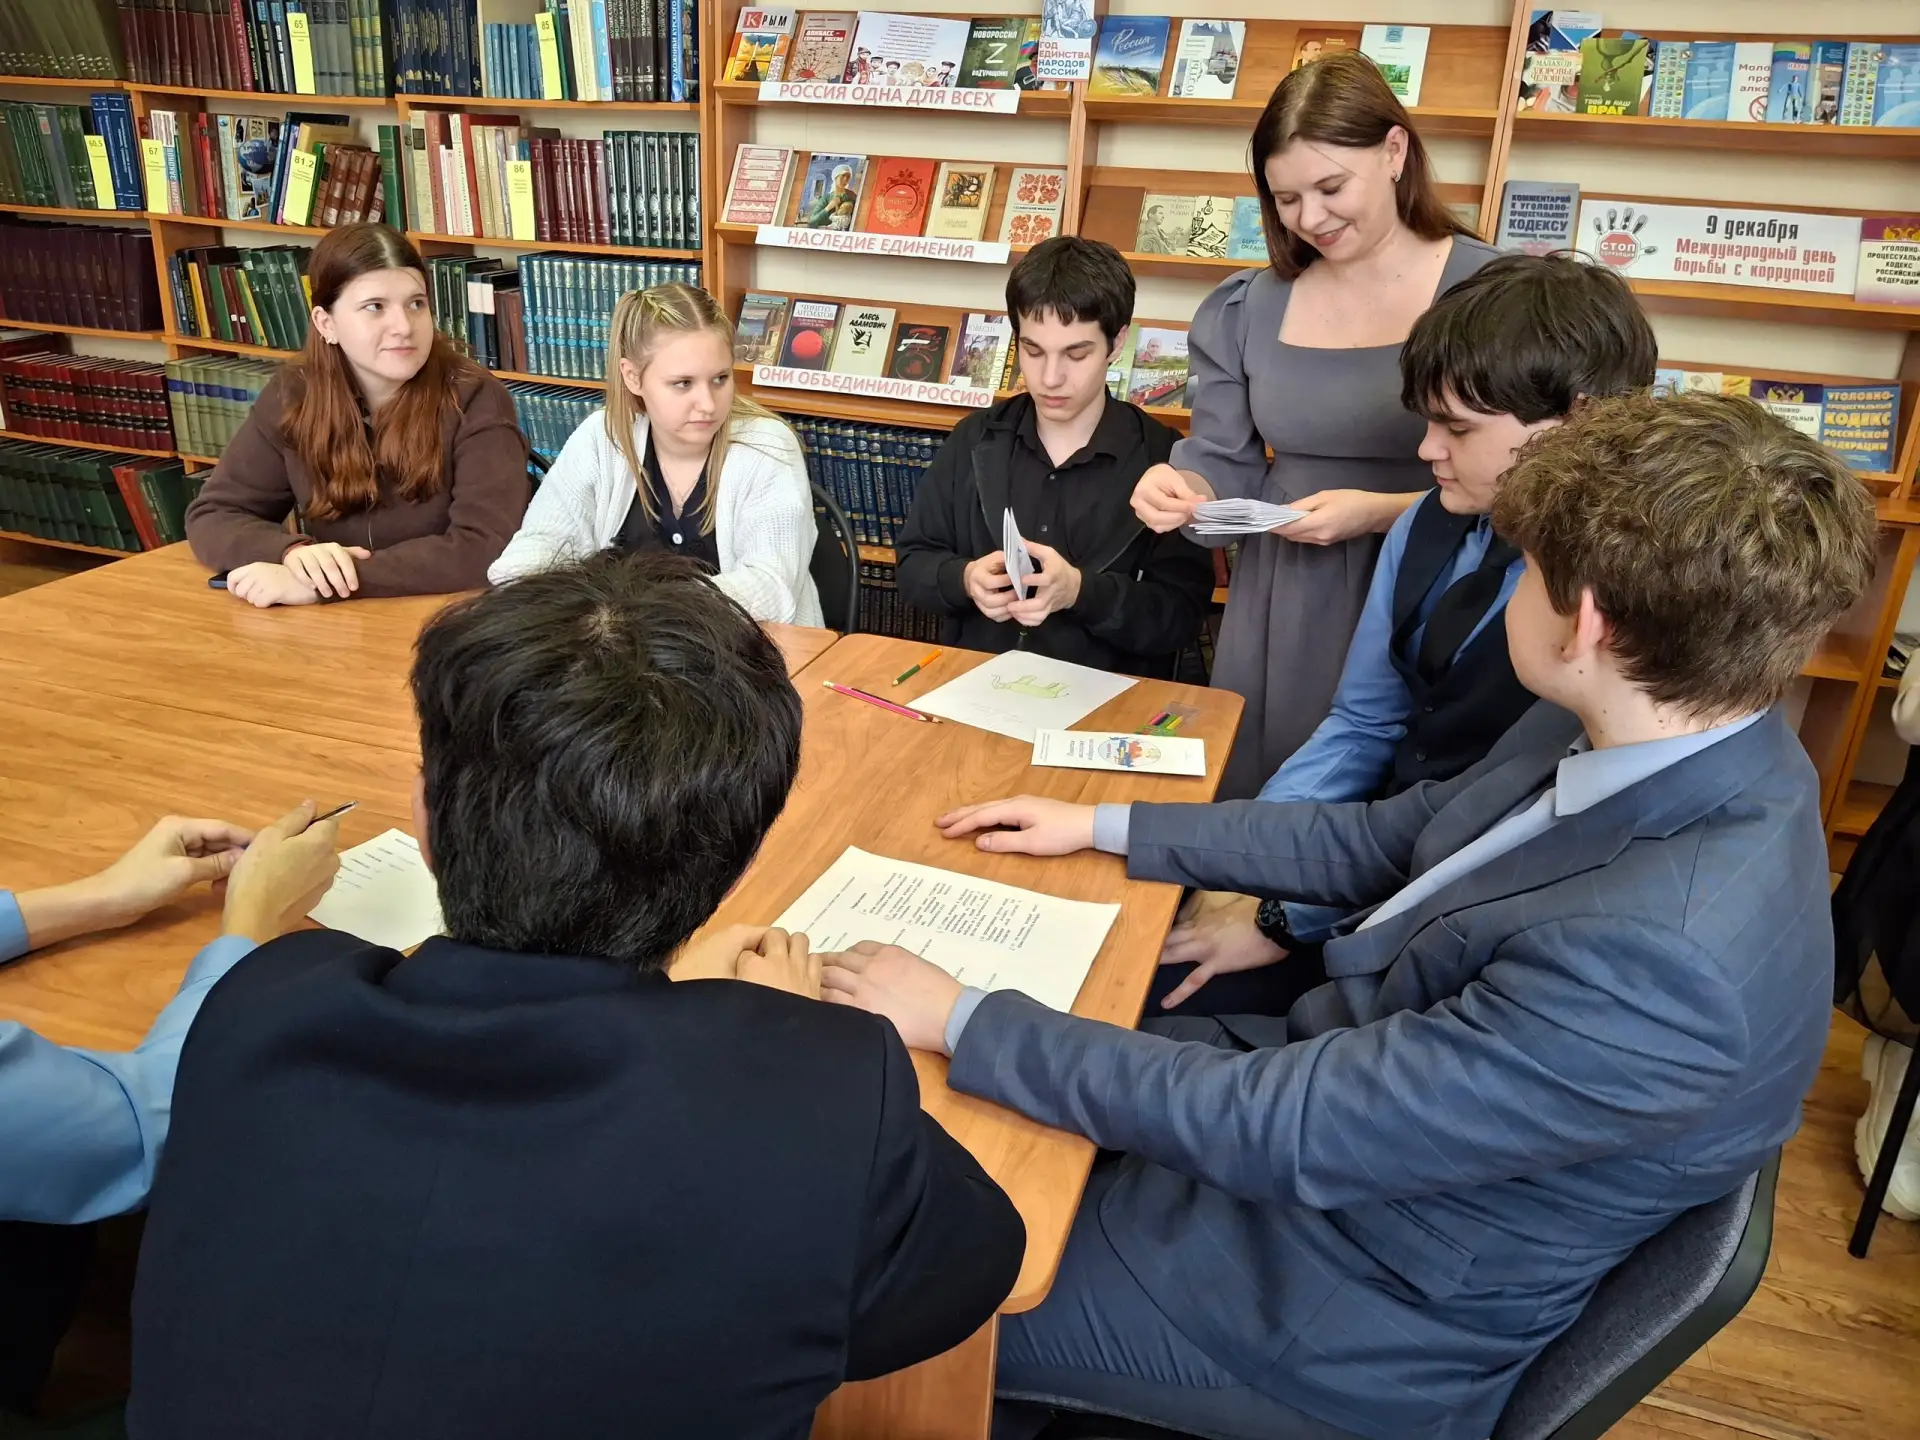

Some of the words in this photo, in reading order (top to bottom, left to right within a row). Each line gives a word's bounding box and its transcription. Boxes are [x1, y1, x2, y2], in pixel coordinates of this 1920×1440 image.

[294, 20, 303, 28] 65
[745, 12, 787, 28] КРЫМ
[973, 30, 1017, 39] НОВОРОССИЯ
[1039, 41, 1058, 50] ГОД
[1039, 51, 1091, 59] ЕДИНСТВА
[1039, 60, 1084, 68] НАРОДОВ
[1038, 68, 1078, 76] РОССИИ
[779, 84, 847, 101] РОССИЯ
[852, 86, 902, 104] ОДНА
[906, 89, 945, 106] ДЛЯ
[951, 91, 995, 107] ВСЕХ
[148, 147, 158, 155] 67
[294, 155, 314, 168] 81.2
[513, 165, 524, 173] 86
[1511, 194, 1571, 203] КОММЕНТАРИЙ
[1520, 203, 1570, 211] УГОЛОВНО-
[1508, 219, 1568, 232] КОДЕКСУ
[1706, 215, 1718, 235] 9
[1724, 219, 1799, 243] декабря
[787, 231, 875, 251] НАСЛЕДИЕ
[880, 239, 974, 259] ЕДИНЕНИЯ
[1601, 241, 1636, 252] СТОП
[1676, 238, 1796, 262] Международный
[1802, 249, 1837, 265] день
[1673, 257, 1726, 276] борьбы
[1734, 264, 1742, 276] с
[1750, 264, 1835, 283] коррупцией
[1886, 261, 1913, 269] КОДЕКС
[1876, 277, 1919, 285] ФЕДЕРАЦИИ
[858, 312, 880, 320] АЛЕСЬ
[849, 319, 887, 330] АДАМОВИЧ
[759, 366, 795, 384] ОНИ
[798, 371, 913, 397] ОБЪЕДИНИЛИ
[916, 384, 990, 406] РОССИЮ
[1827, 391, 1894, 402] УГОЛОВНО-
[1824, 411, 1892, 428] КОДЕКС
[1823, 428, 1890, 439] РОССИЙСКОЙ
[1822, 439, 1888, 452] ФЕДЕРАЦИИ
